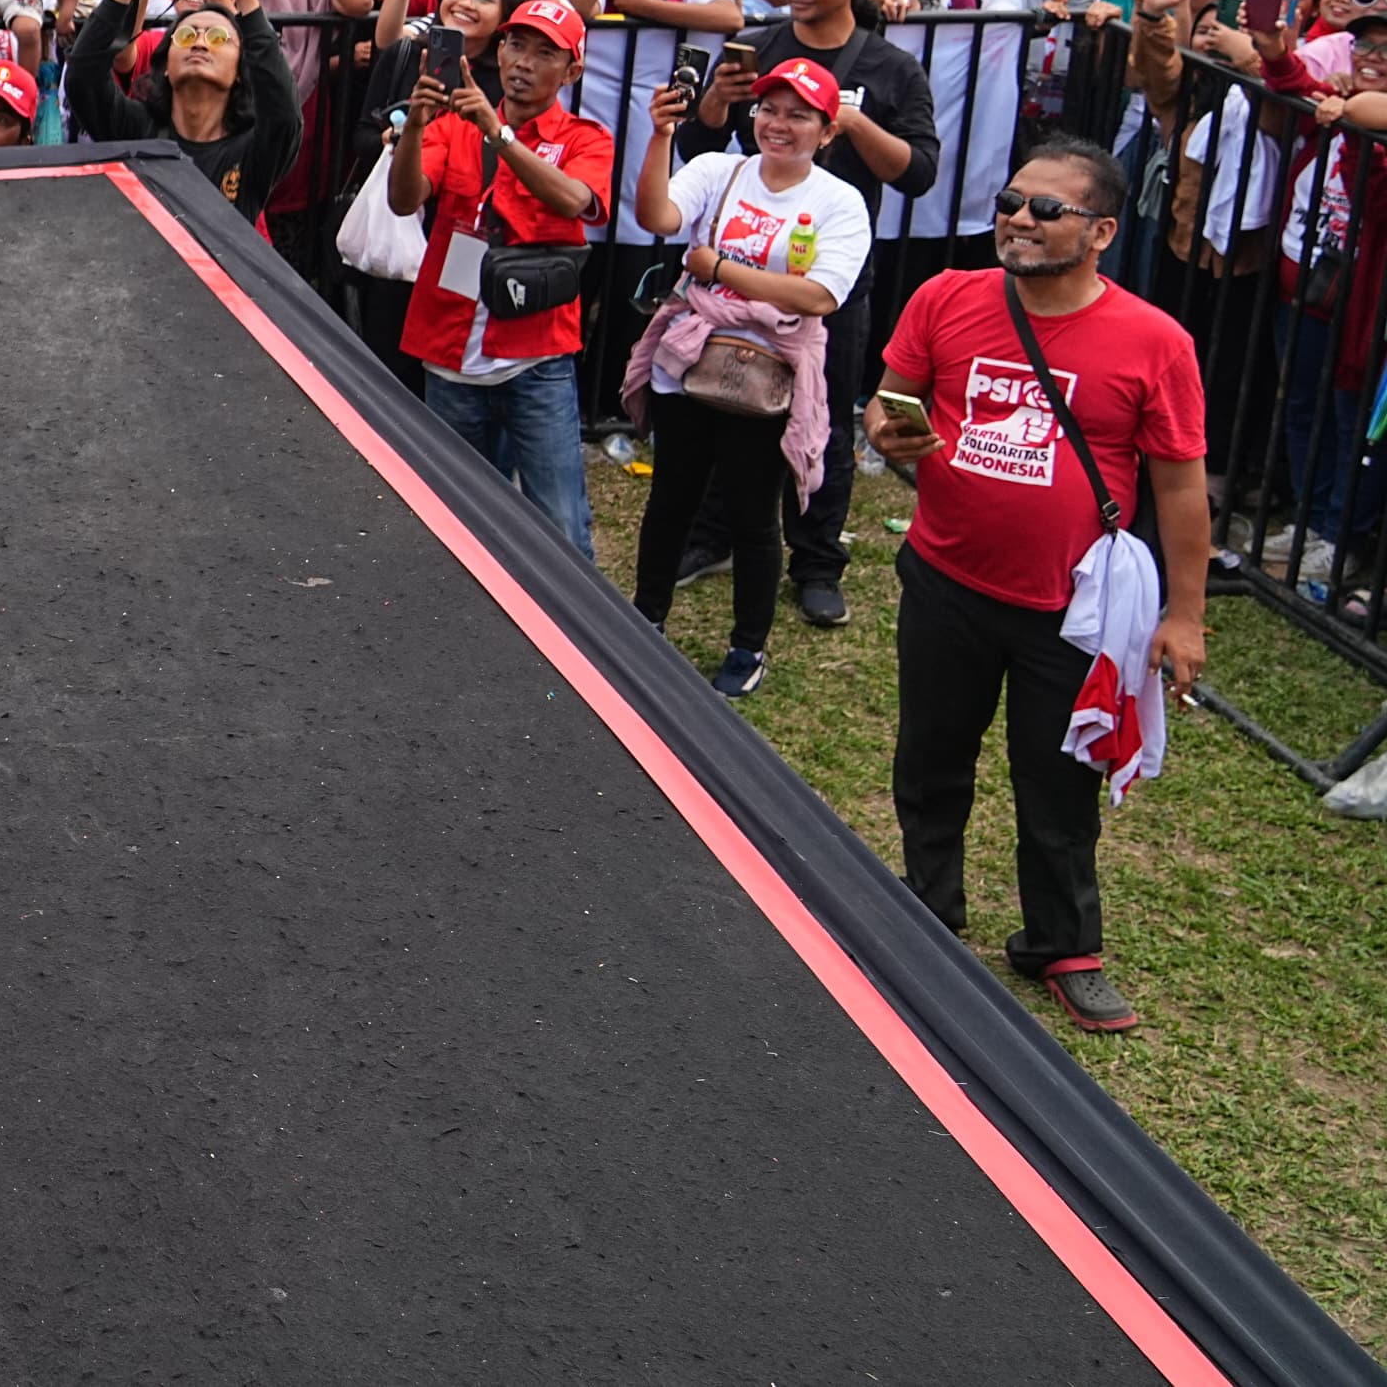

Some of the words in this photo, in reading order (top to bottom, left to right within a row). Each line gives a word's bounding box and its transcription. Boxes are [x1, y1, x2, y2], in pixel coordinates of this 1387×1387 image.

[966, 374, 1021, 404] PSI
[964, 425, 1009, 443] PARTAI
[961, 436, 1048, 462] SOLIDARITAS
[957, 449, 1046, 479] INDONESIA
